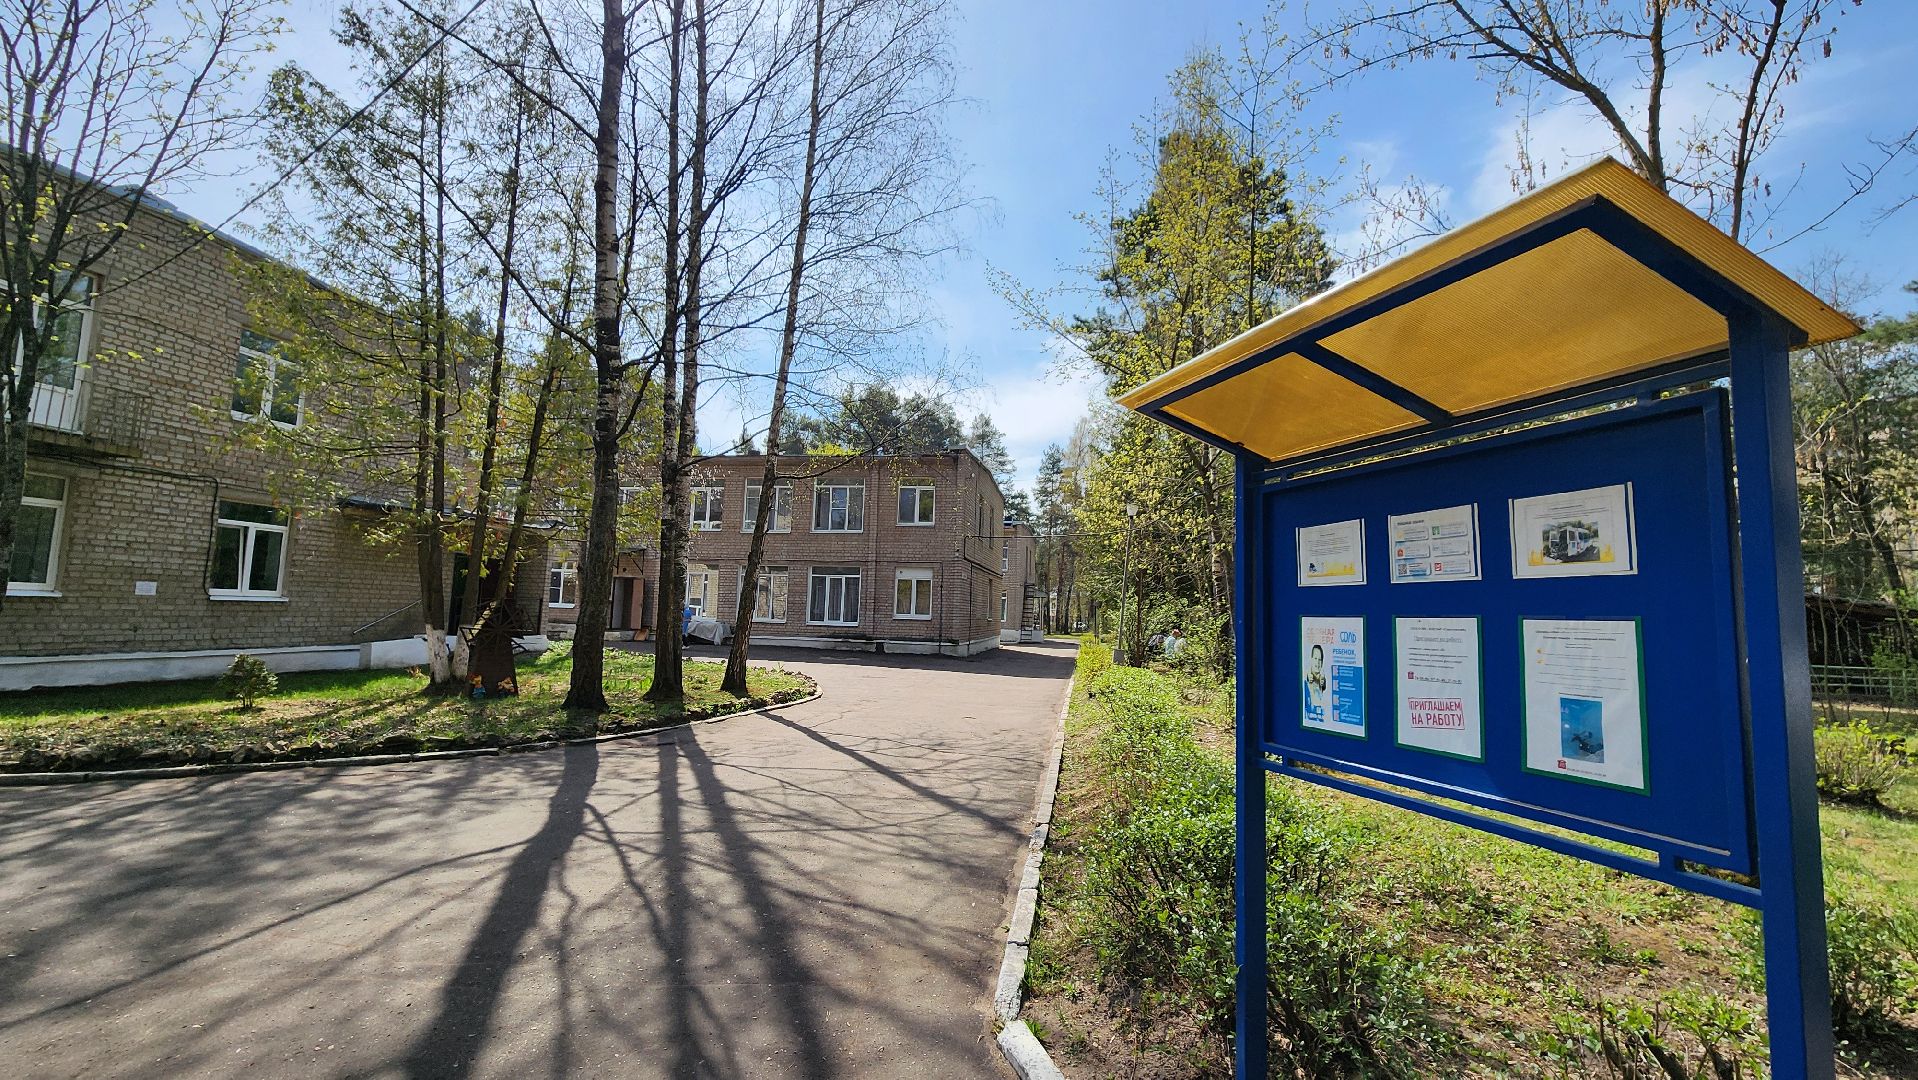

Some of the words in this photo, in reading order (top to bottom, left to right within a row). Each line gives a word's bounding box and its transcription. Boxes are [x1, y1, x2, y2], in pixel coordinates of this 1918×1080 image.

[1409, 700, 1462, 711] ПРИГЛАШАЕМ
[1411, 712, 1424, 725] НА
[1426, 713, 1462, 726] РАБОТУ
